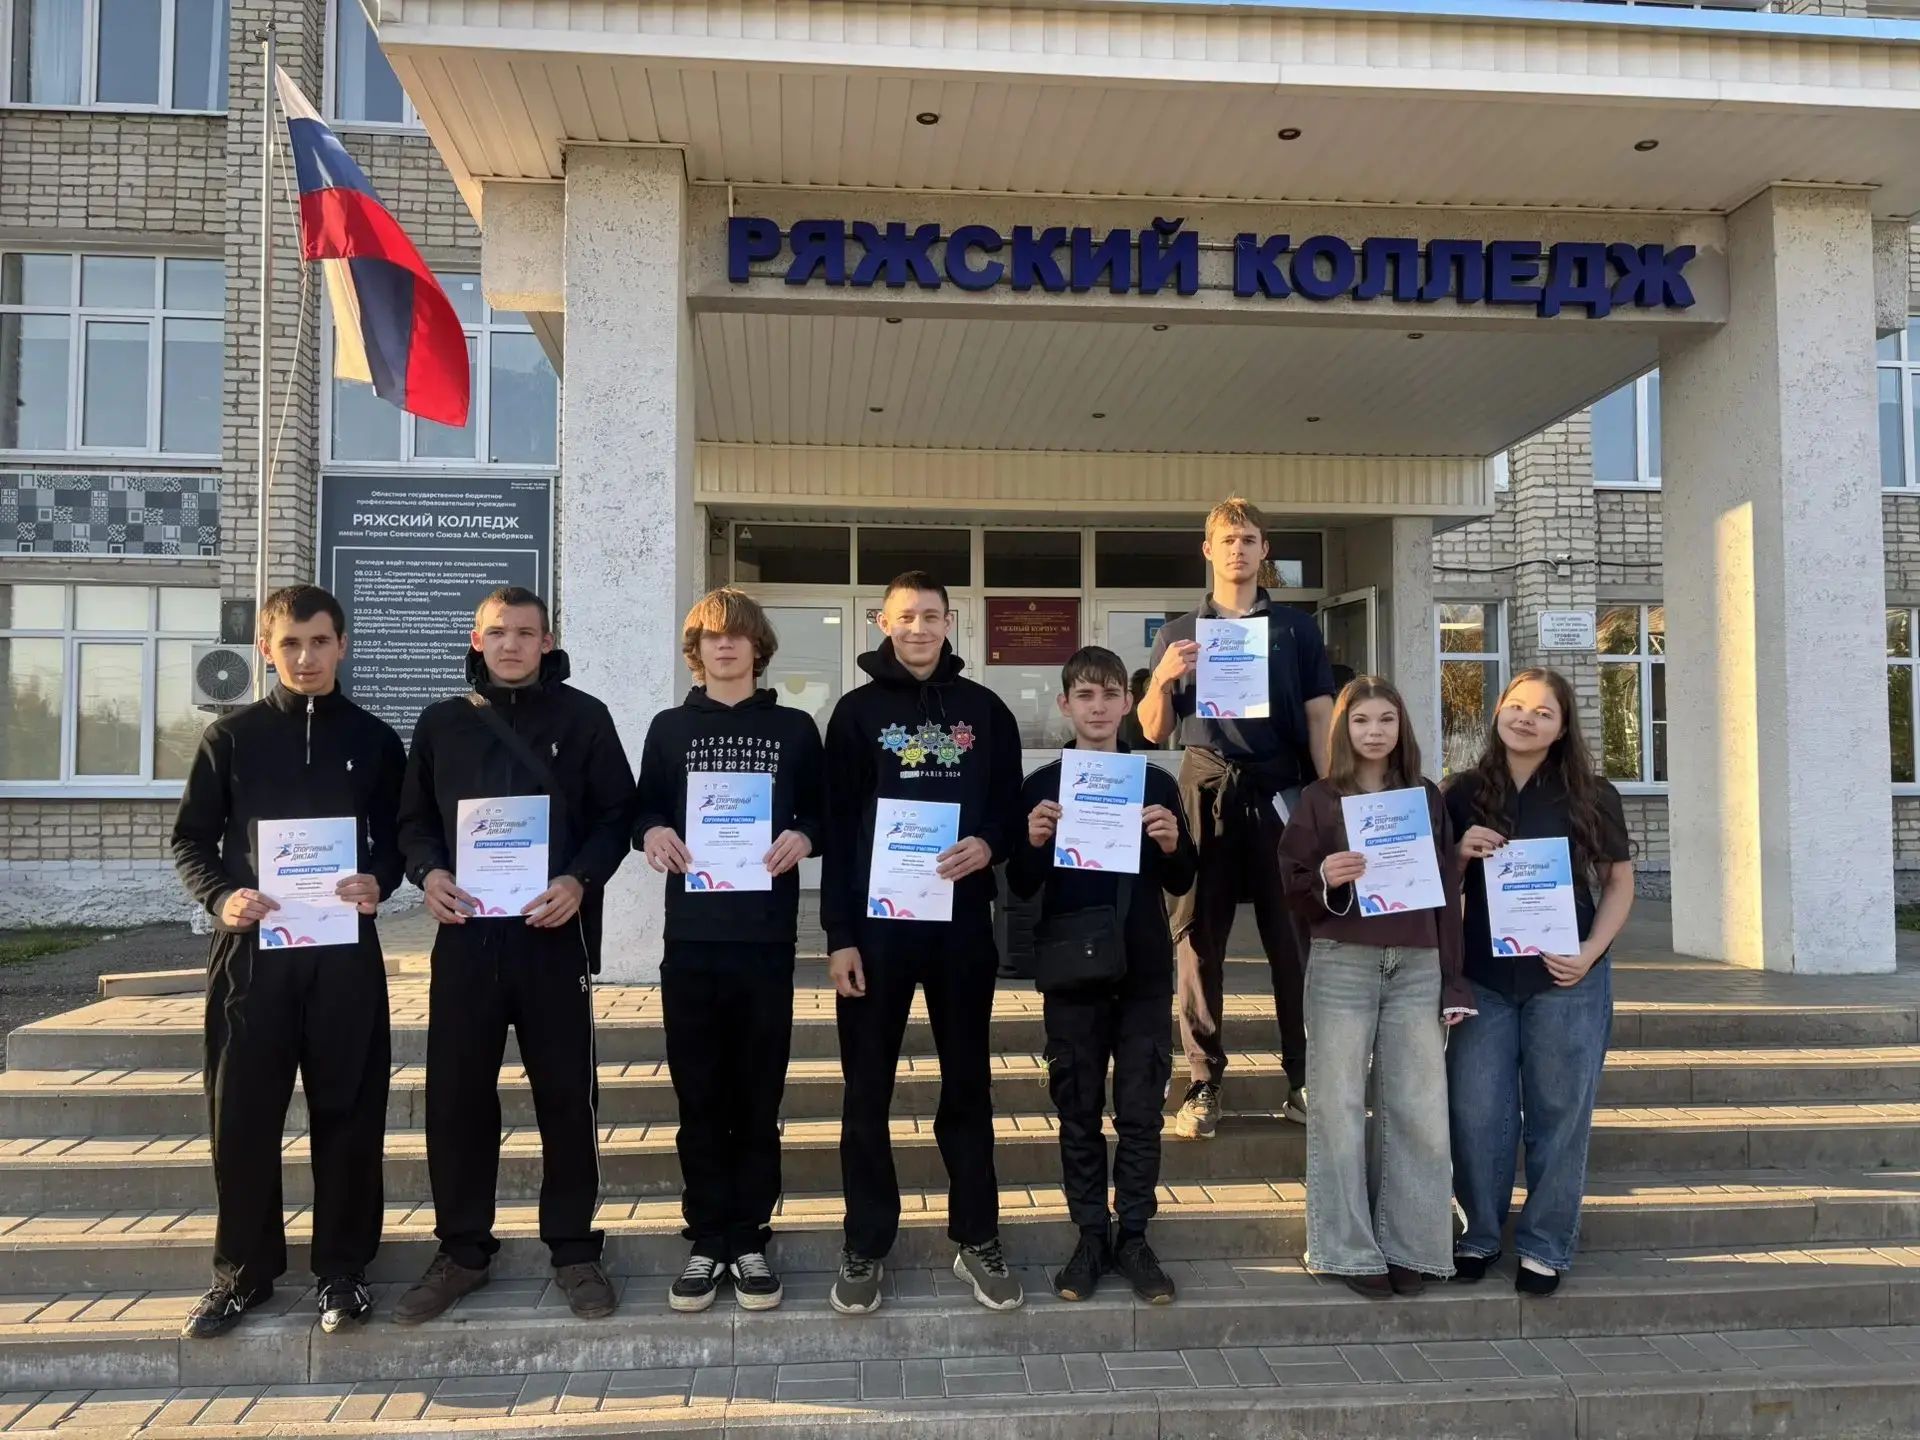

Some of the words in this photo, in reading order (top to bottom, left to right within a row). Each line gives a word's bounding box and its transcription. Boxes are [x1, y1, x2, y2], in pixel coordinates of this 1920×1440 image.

[728, 216, 1198, 296] РЯЖСКИЙ
[1233, 232, 1696, 318] КОЛЛЕДЖ
[353, 513, 432, 527] РЯЖСКИЙ
[438, 516, 519, 529] КОЛЛЕДЖ
[692, 739, 697, 747] 0
[709, 737, 714, 745] 2
[738, 737, 744, 745] 5
[686, 751, 696, 759] 10
[699, 750, 708, 758] 11
[713, 749, 723, 757] 12
[727, 749, 737, 757] 13
[741, 749, 751, 757] 14
[755, 750, 766, 758] 15
[770, 752, 779, 760] 16
[686, 763, 695, 771] 17
[698, 761, 708, 770] 18
[712, 761, 722, 769] 19
[725, 761, 736, 769] 20
[740, 761, 750, 769] 21
[754, 762, 765, 771] 22
[768, 764, 778, 772] 23
[716, 795, 751, 804] СПОРТИВНЫЙ
[292, 844, 334, 853] СПОРТИВНЫЙ
[290, 853, 319, 861] ДИКТАНТ
